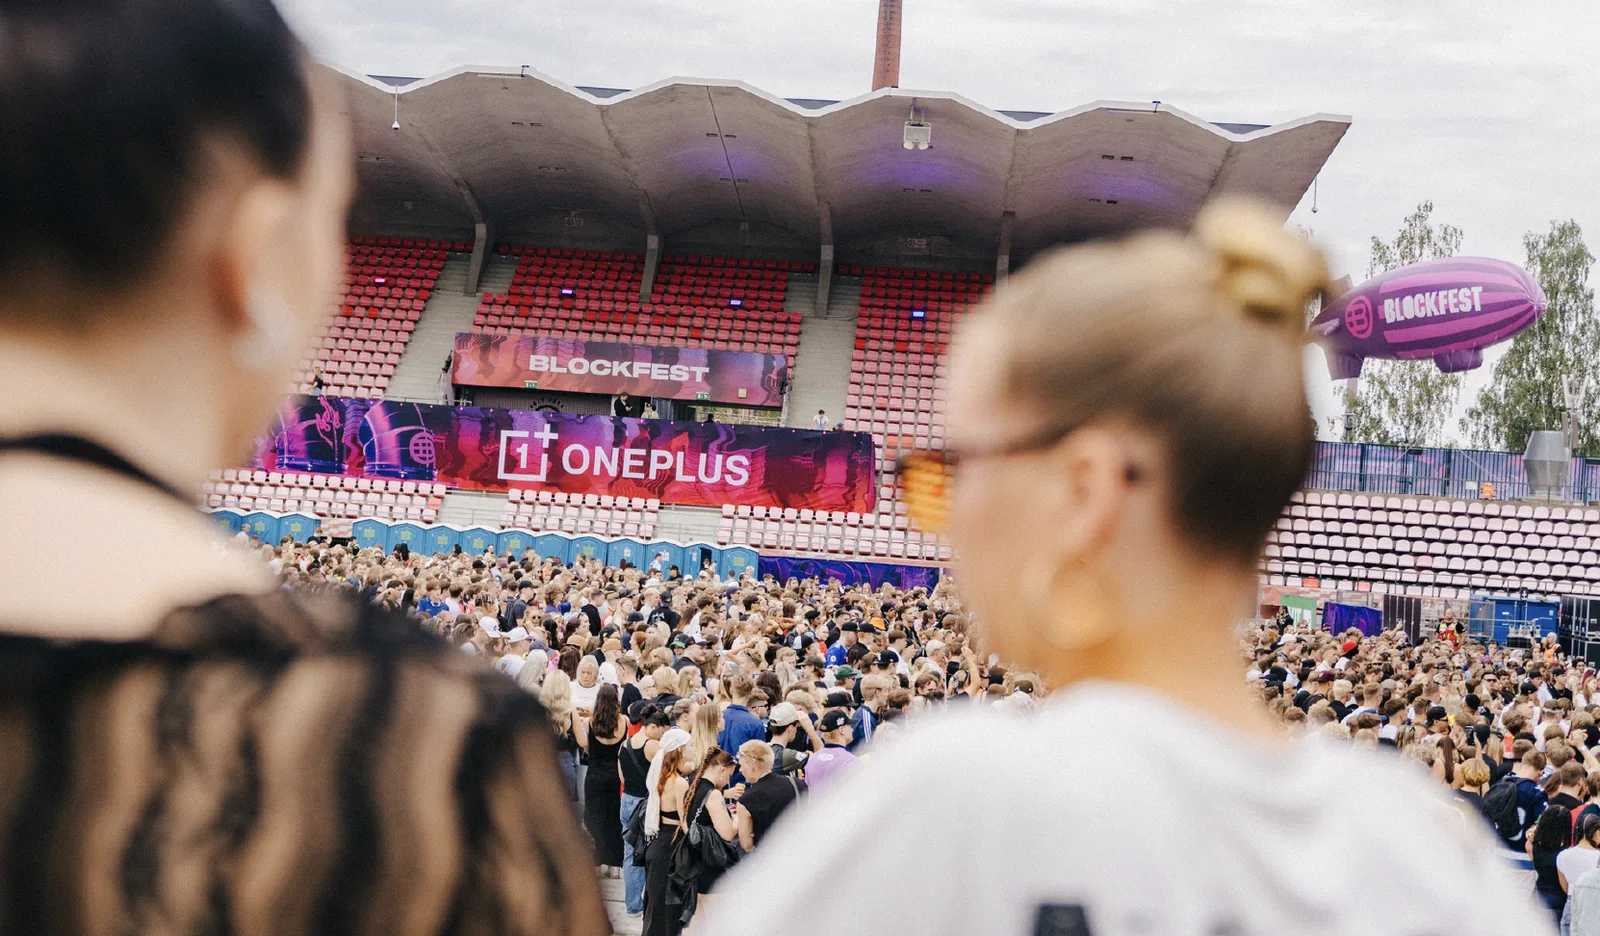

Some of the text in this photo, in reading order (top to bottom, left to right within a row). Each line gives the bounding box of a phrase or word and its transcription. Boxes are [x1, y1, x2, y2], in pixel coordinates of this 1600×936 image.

[1384, 286, 1483, 324] BLOCKFEST
[528, 354, 710, 383] BLOCKFEST
[561, 443, 750, 487] ONEPLUS
